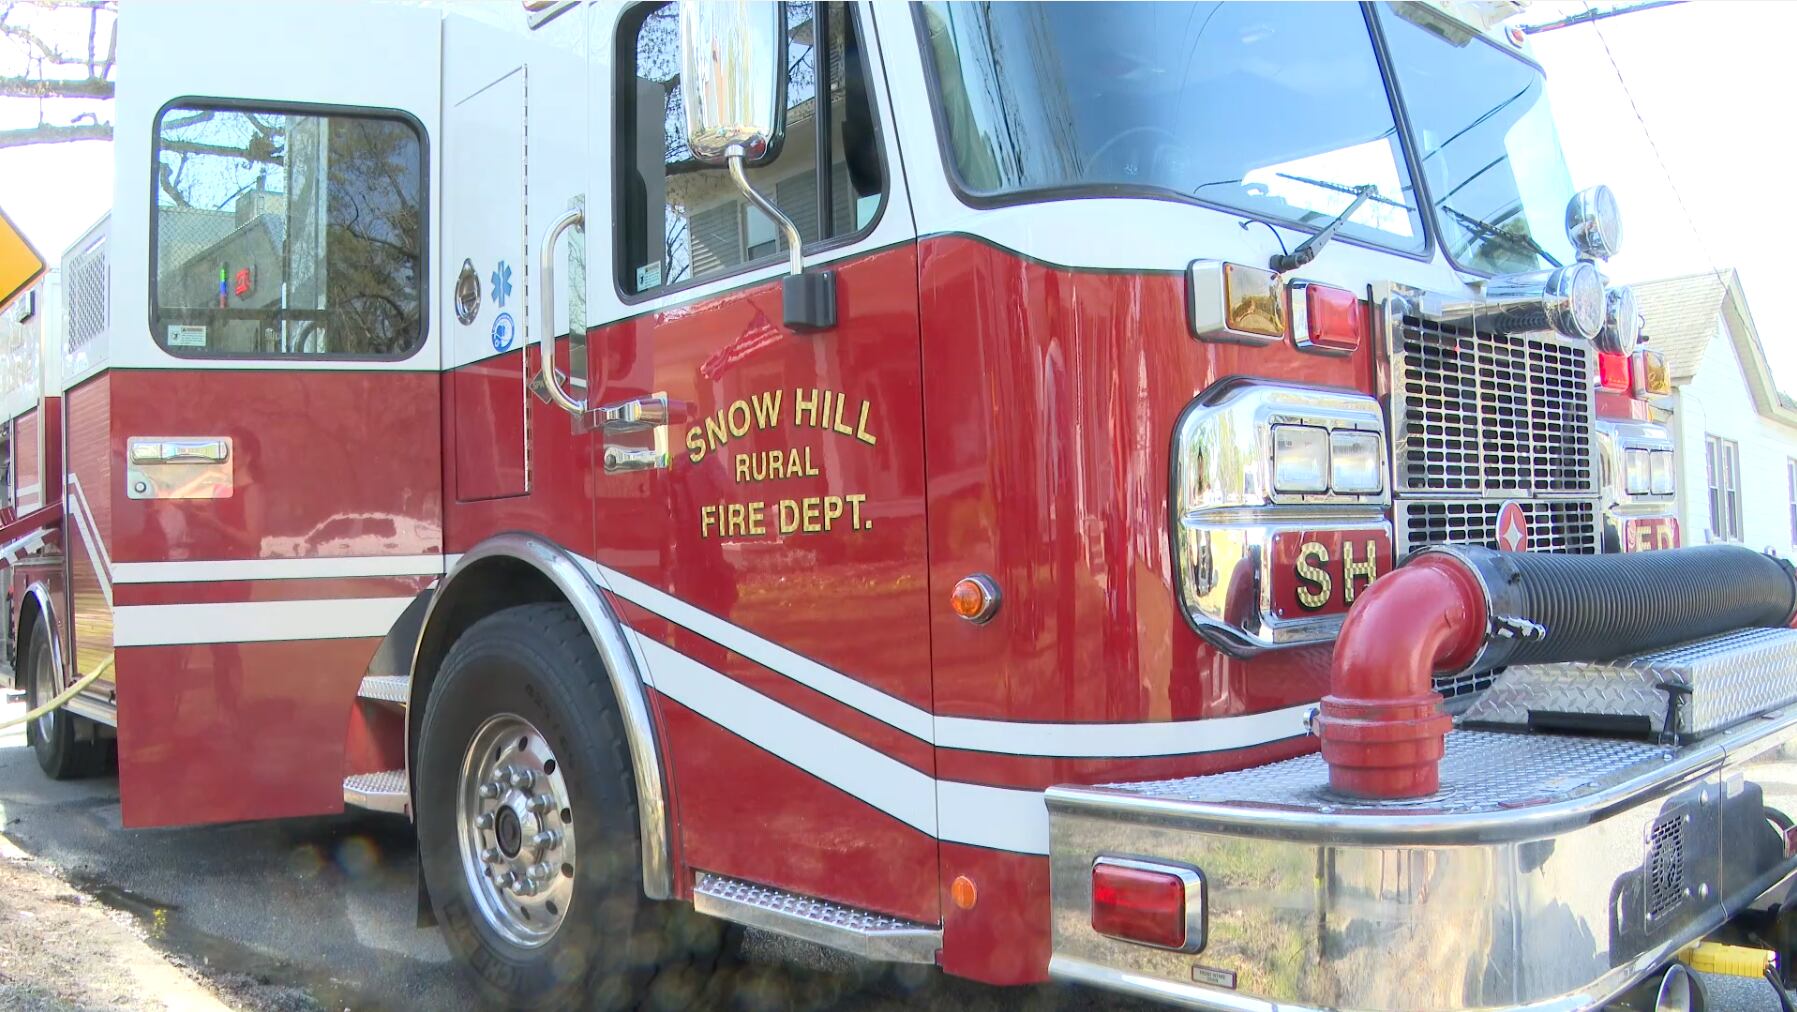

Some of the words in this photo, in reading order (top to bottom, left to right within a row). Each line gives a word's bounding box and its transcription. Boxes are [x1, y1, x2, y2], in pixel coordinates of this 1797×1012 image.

[685, 389, 783, 463] SNOW
[795, 388, 877, 446] HILL
[735, 446, 819, 482] RURAL
[701, 501, 766, 539] FIRE
[779, 494, 873, 534] DEPT.
[1295, 539, 1377, 610] SH
